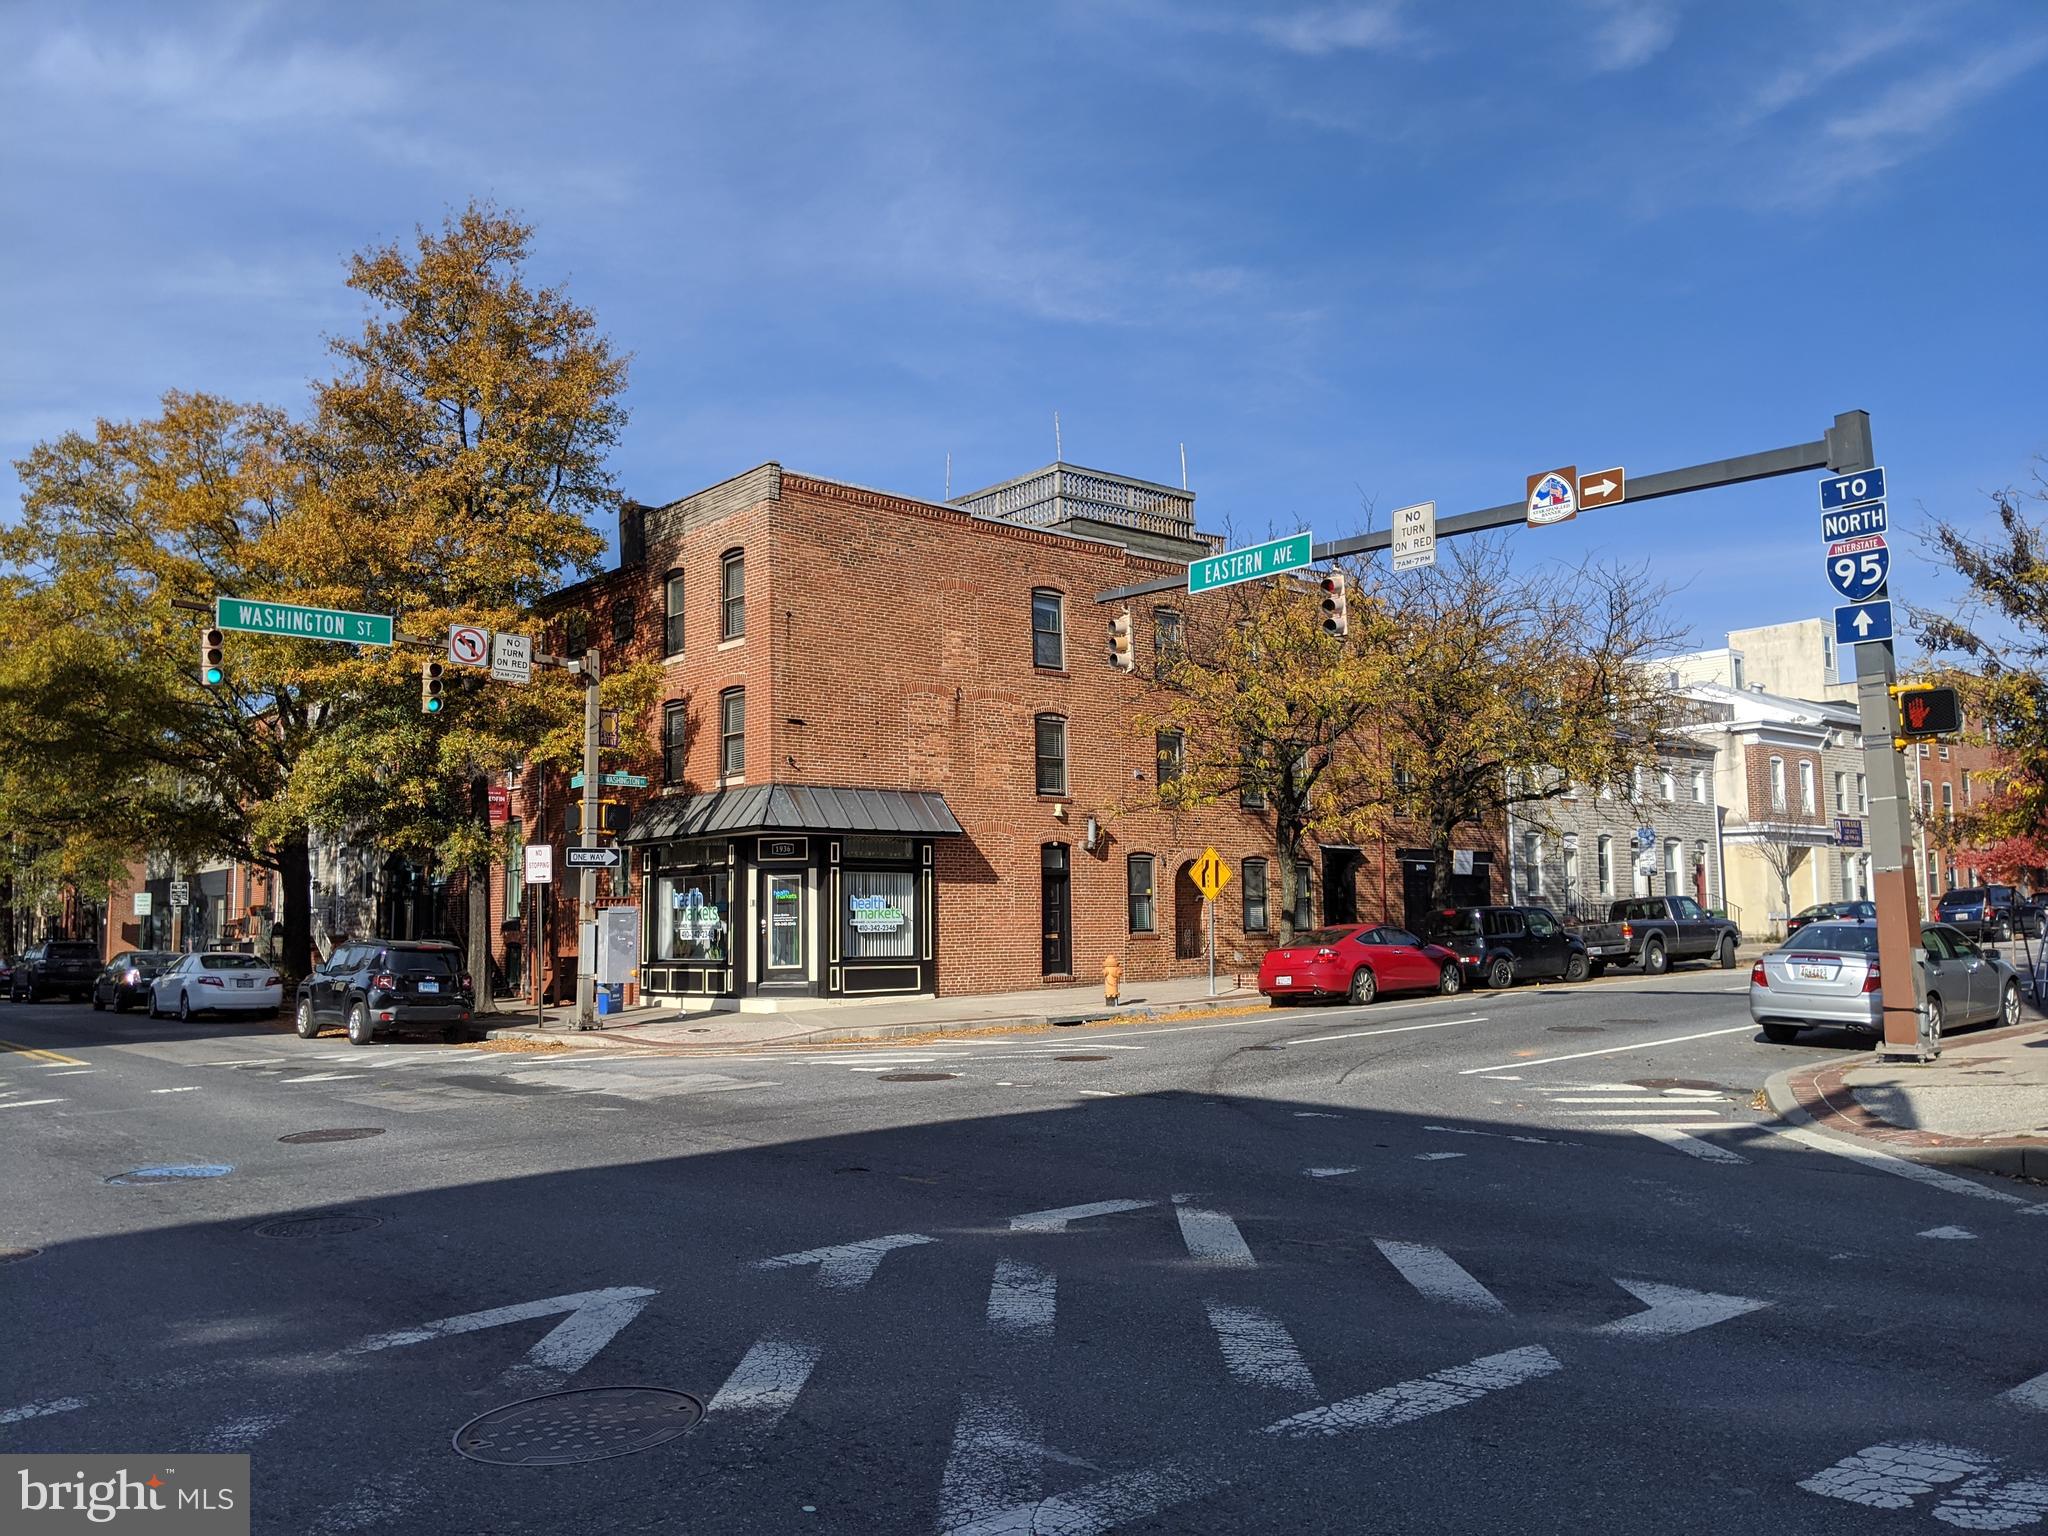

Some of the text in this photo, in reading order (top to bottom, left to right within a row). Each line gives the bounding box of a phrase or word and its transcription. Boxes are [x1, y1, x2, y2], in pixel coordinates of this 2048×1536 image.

[1835, 478, 1867, 500] TO
[1405, 511, 1421, 523] NO
[1825, 509, 1883, 537] NORTH
[1401, 524, 1425, 537] TURN
[1395, 536, 1432, 552] ON RED
[1834, 538, 1879, 554] INTERSTATE
[1205, 545, 1296, 584] EASTERN AVE.
[1396, 555, 1431, 569] 7AM-7PM
[1834, 553, 1882, 589] 95
[239, 605, 375, 638] WASHINGTON ST.
[506, 639, 521, 648] NO
[502, 648, 524, 659] TURN
[496, 658, 528, 669] ON RED
[495, 671, 526, 679] 7AM-7PM
[606, 775, 640, 785] WASHINGTON
[572, 853, 605, 861] ONE WAY
[529, 861, 549, 869] STOPPING
[673, 889, 703, 907] health
[851, 896, 885, 909] health
[856, 907, 901, 919] markets
